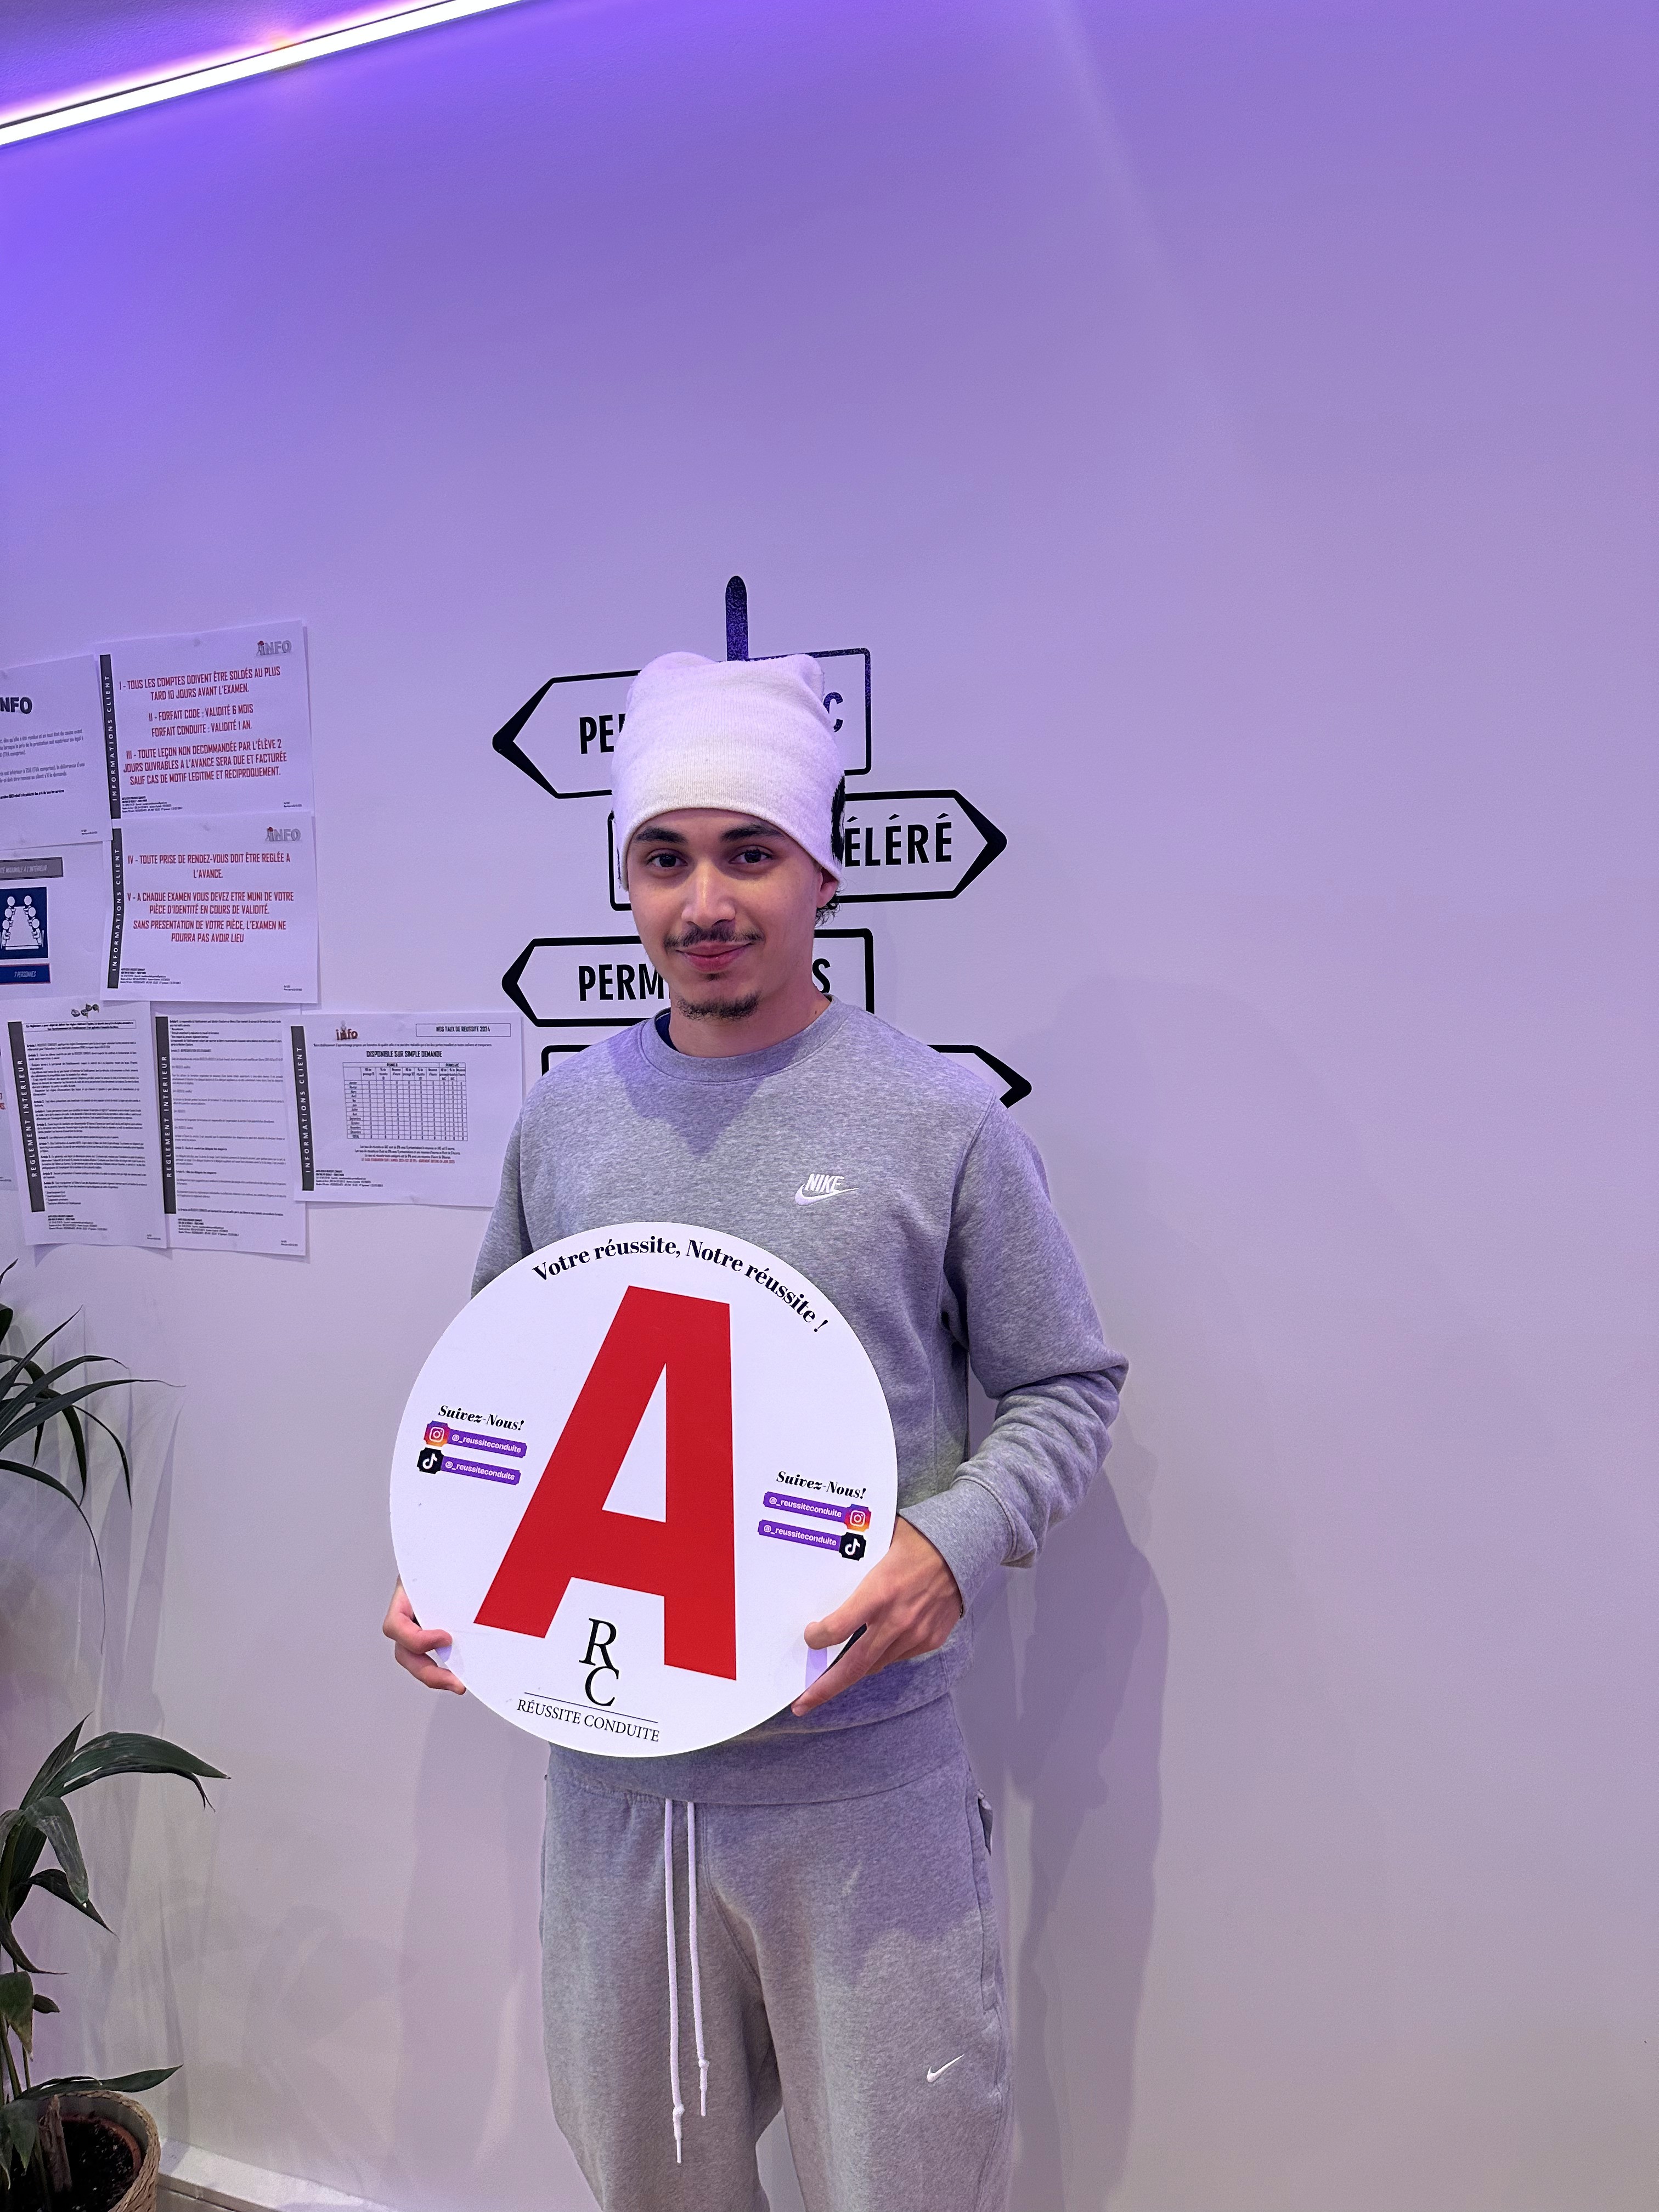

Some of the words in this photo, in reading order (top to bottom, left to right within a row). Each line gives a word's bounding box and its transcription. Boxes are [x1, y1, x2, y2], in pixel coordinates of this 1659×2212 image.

[127, 679, 143, 690] TOUS
[144, 678, 156, 689] LES
[157, 675, 185, 687] COMPTES
[187, 673, 212, 685] DOIVENT
[213, 670, 228, 682] ÊTRE
[229, 667, 253, 680] SOLDÉS
[254, 668, 263, 678] AU
[264, 665, 280, 677] PLUS
[150, 691, 166, 701] TARD
[168, 690, 174, 699] 10
[176, 687, 196, 699] JOURS
[198, 686, 217, 697] AVANT
[218, 682, 250, 695] L'EXAMEN.
[159, 710, 183, 721] FORFAIT
[184, 708, 200, 719] CODE
[205, 704, 230, 717] VALIDITÉ
[232, 705, 236, 715] 6
[238, 703, 253, 714] MOIS
[151, 726, 176, 737] FORFAIT
[177, 724, 206, 736] CONDUITE
[211, 719, 236, 733] VALIDITÉ
[242, 720, 252, 730] AN.
[137, 748, 156, 759] TOUTE
[157, 747, 177, 759] LEÇON
[178, 746, 191, 756] NON
[192, 741, 237, 755] DECOMMANDÉE
[238, 741, 251, 752] PAR
[252, 738, 276, 751] L'ÉLÈVE
[277, 739, 282, 749] 2
[108, 719, 117, 802] INFORMATIONS
[123, 762, 143, 773] JOURS
[144, 760, 179, 771] OUVRABLES
[180, 759, 184, 769] A
[185, 756, 215, 769] L'AVANCE
[216, 756, 232, 766] SERA
[233, 755, 245, 765] DUE
[246, 754, 254, 764] ET
[255, 750, 287, 764] FACTURÉE
[129, 775, 145, 785] SAUF
[146, 774, 159, 785] CAS
[160, 774, 168, 783] DE
[169, 772, 187, 783] MOTIF
[188, 770, 215, 782] LEGITIME
[216, 770, 223, 780] ET
[224, 766, 281, 779] RECIPROQUEMENT.
[844, 812, 952, 867] ÉLÉRÉ
[128, 855, 134, 865] IV
[139, 855, 158, 864] TOUTE
[159, 854, 177, 864] PRISE
[178, 854, 186, 864] DE
[187, 854, 229, 864] RENDEZ-VOUS
[230, 853, 244, 863] DOIT
[246, 851, 261, 863] ÊTRE
[262, 851, 284, 862] REGLÉE
[286, 853, 290, 862] A
[193, 869, 223, 878] L'AVANCE.
[127, 892, 131, 901] V
[137, 892, 142, 901] A
[143, 892, 166, 901] CHAQUE
[167, 892, 191, 901] EXAMEN
[193, 892, 209, 901] VOUS
[211, 891, 229, 901] DEVEZ
[230, 891, 245, 901] ETRE
[247, 891, 263, 901] MUNI
[264, 891, 272, 901] DE
[274, 891, 294, 901] VOTRE
[149, 903, 166, 914] PIÈCE
[167, 903, 199, 914] D'IDENTITÉ
[200, 905, 208, 914] EN
[210, 905, 230, 914] COURS
[232, 905, 240, 914] DE
[242, 903, 270, 914] VALIDITÉ.
[111, 891, 122, 971] INFORMATIONS
[133, 920, 149, 929] SANS
[150, 920, 194, 929] PRESENTATION
[195, 920, 204, 929] DE
[205, 920, 224, 929] VOTRE
[225, 918, 245, 930] PIÈCE,
[246, 921, 276, 930] L'EXAMEN
[278, 921, 286, 930] NE
[171, 933, 196, 942] POURRA
[197, 933, 210, 943] PAS
[211, 933, 229, 943] AVOIR
[230, 933, 244, 943] LIEU
[812, 958, 831, 994] S
[296, 1047, 305, 1084] CLIENT
[17, 1060, 30, 1114] INTERIEUR
[161, 1056, 170, 1111] INTERIEUR
[300, 1091, 311, 1173] INFORMATIONS
[24, 1120, 38, 1178] REGLEMENT
[164, 1118, 172, 1178] REGLEMENT
[804, 1173, 845, 1193] NIKE
[532, 1250, 591, 1281] Votre
[594, 1235, 681, 1260] réussite,
[685, 1239, 744, 1272] Notre
[744, 1267, 816, 1324] réussite
[813, 1319, 828, 1333] !
[438, 1404, 524, 1431] Suivez-Nous!
[452, 1434, 522, 1453] @_reussiteconduite
[445, 1461, 515, 1480] @_reussiteconduite
[473, 1284, 737, 1681] A
[776, 1470, 866, 1499] Suivez-Nous!
[769, 1497, 842, 1518] @_reussiteconduite
[763, 1525, 837, 1546] @_reussiteconduite
[517, 1699, 582, 1724] RÉUSSITE
[584, 1714, 660, 1742] CONDUITE
